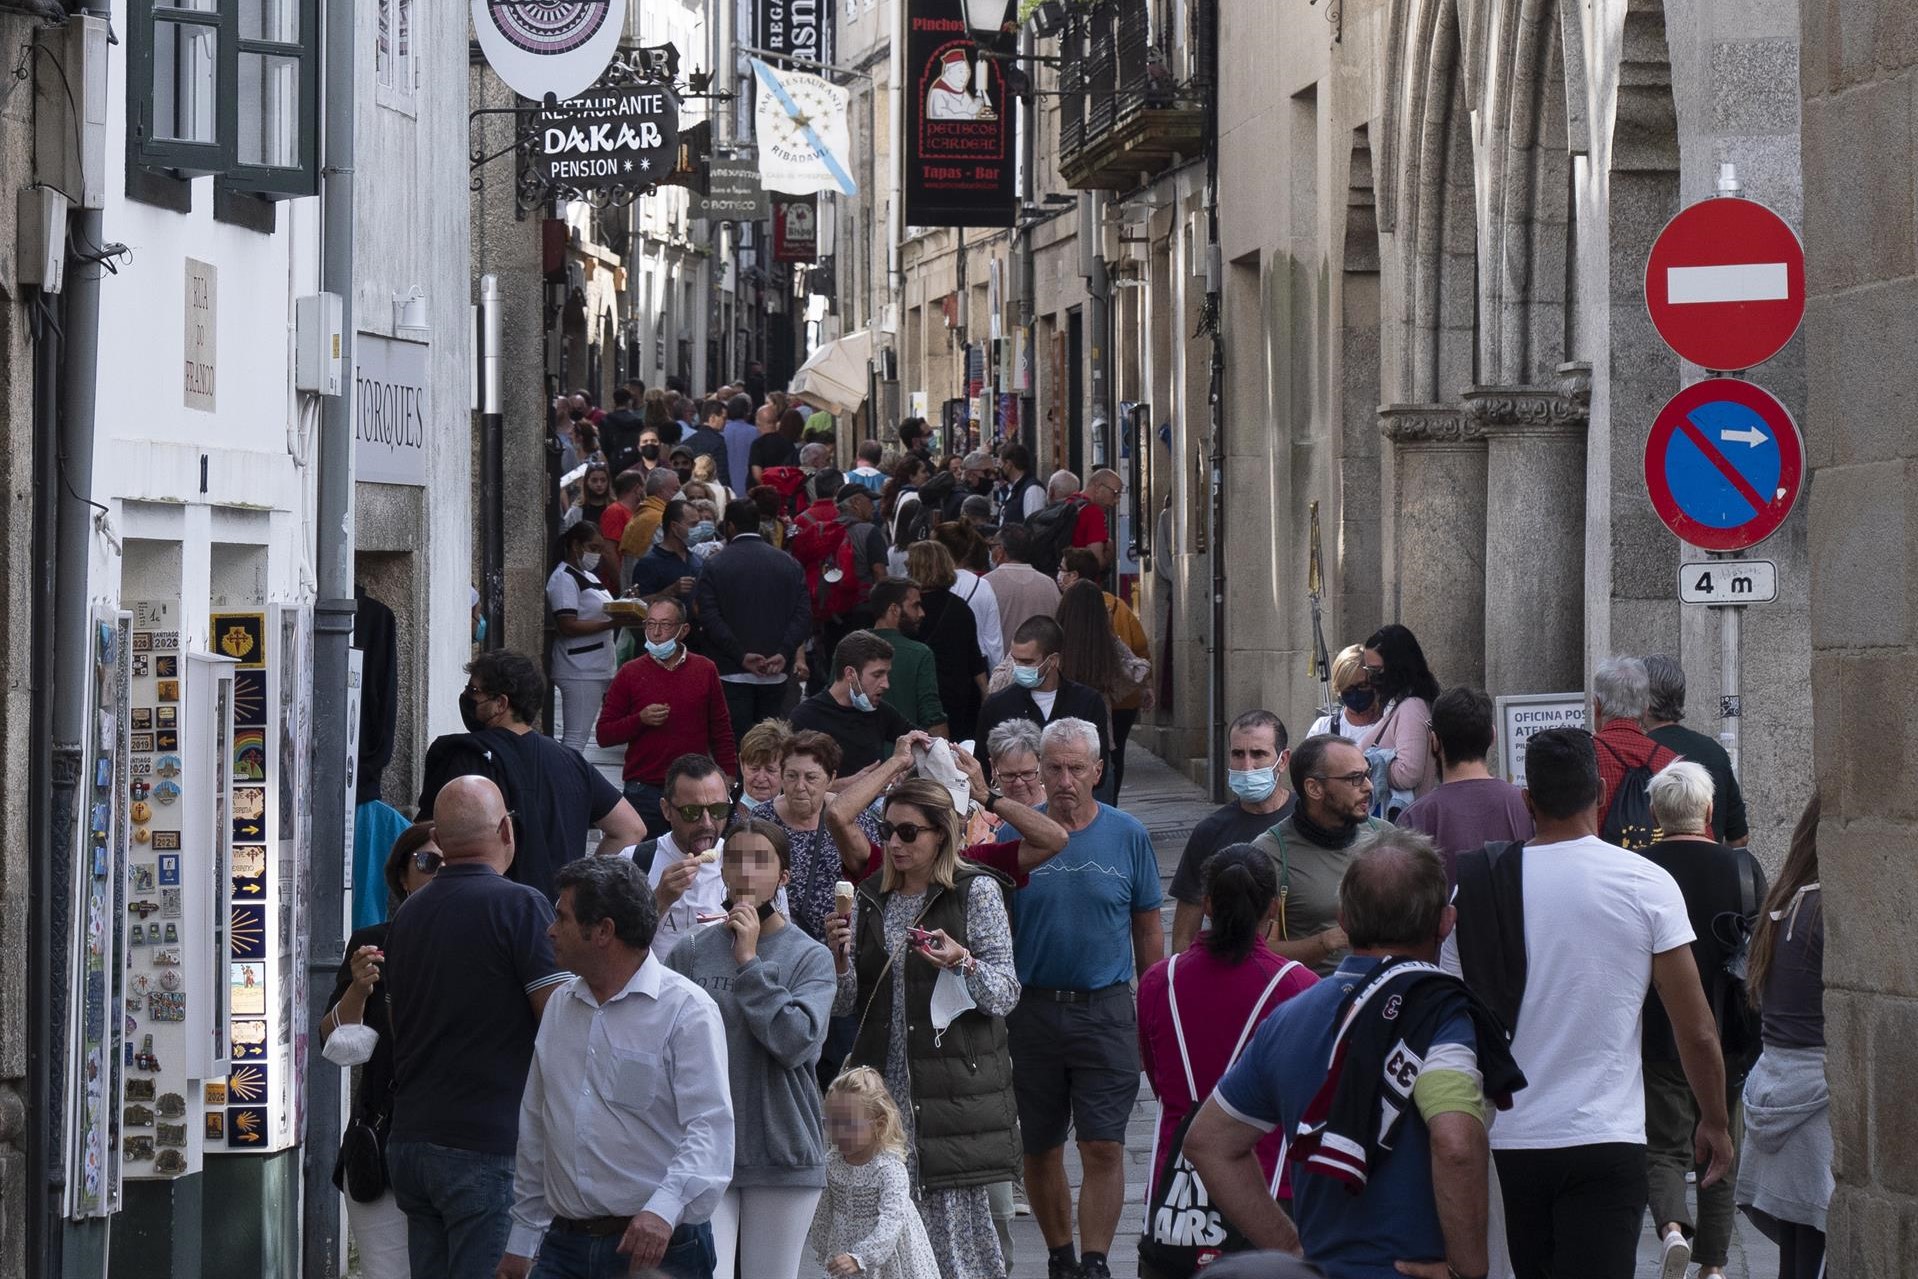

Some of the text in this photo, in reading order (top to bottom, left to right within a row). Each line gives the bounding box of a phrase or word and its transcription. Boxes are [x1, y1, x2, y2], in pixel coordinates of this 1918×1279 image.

[543, 121, 663, 154] DAKAR
[551, 158, 619, 178] PENSION
[922, 166, 962, 181] Tapas
[975, 166, 1000, 180] Bar
[193, 275, 209, 311] RUA
[196, 323, 206, 347] DO
[185, 360, 216, 397] FRANCO
[355, 365, 424, 454] TORQUES
[1694, 571, 1753, 595] 4 m
[132, 640, 148, 649] 020
[154, 638, 180, 649] 2020
[1514, 711, 1563, 723] OFICINA
[130, 740, 149, 750] 2019
[1153, 1206, 1228, 1248] AIRS
